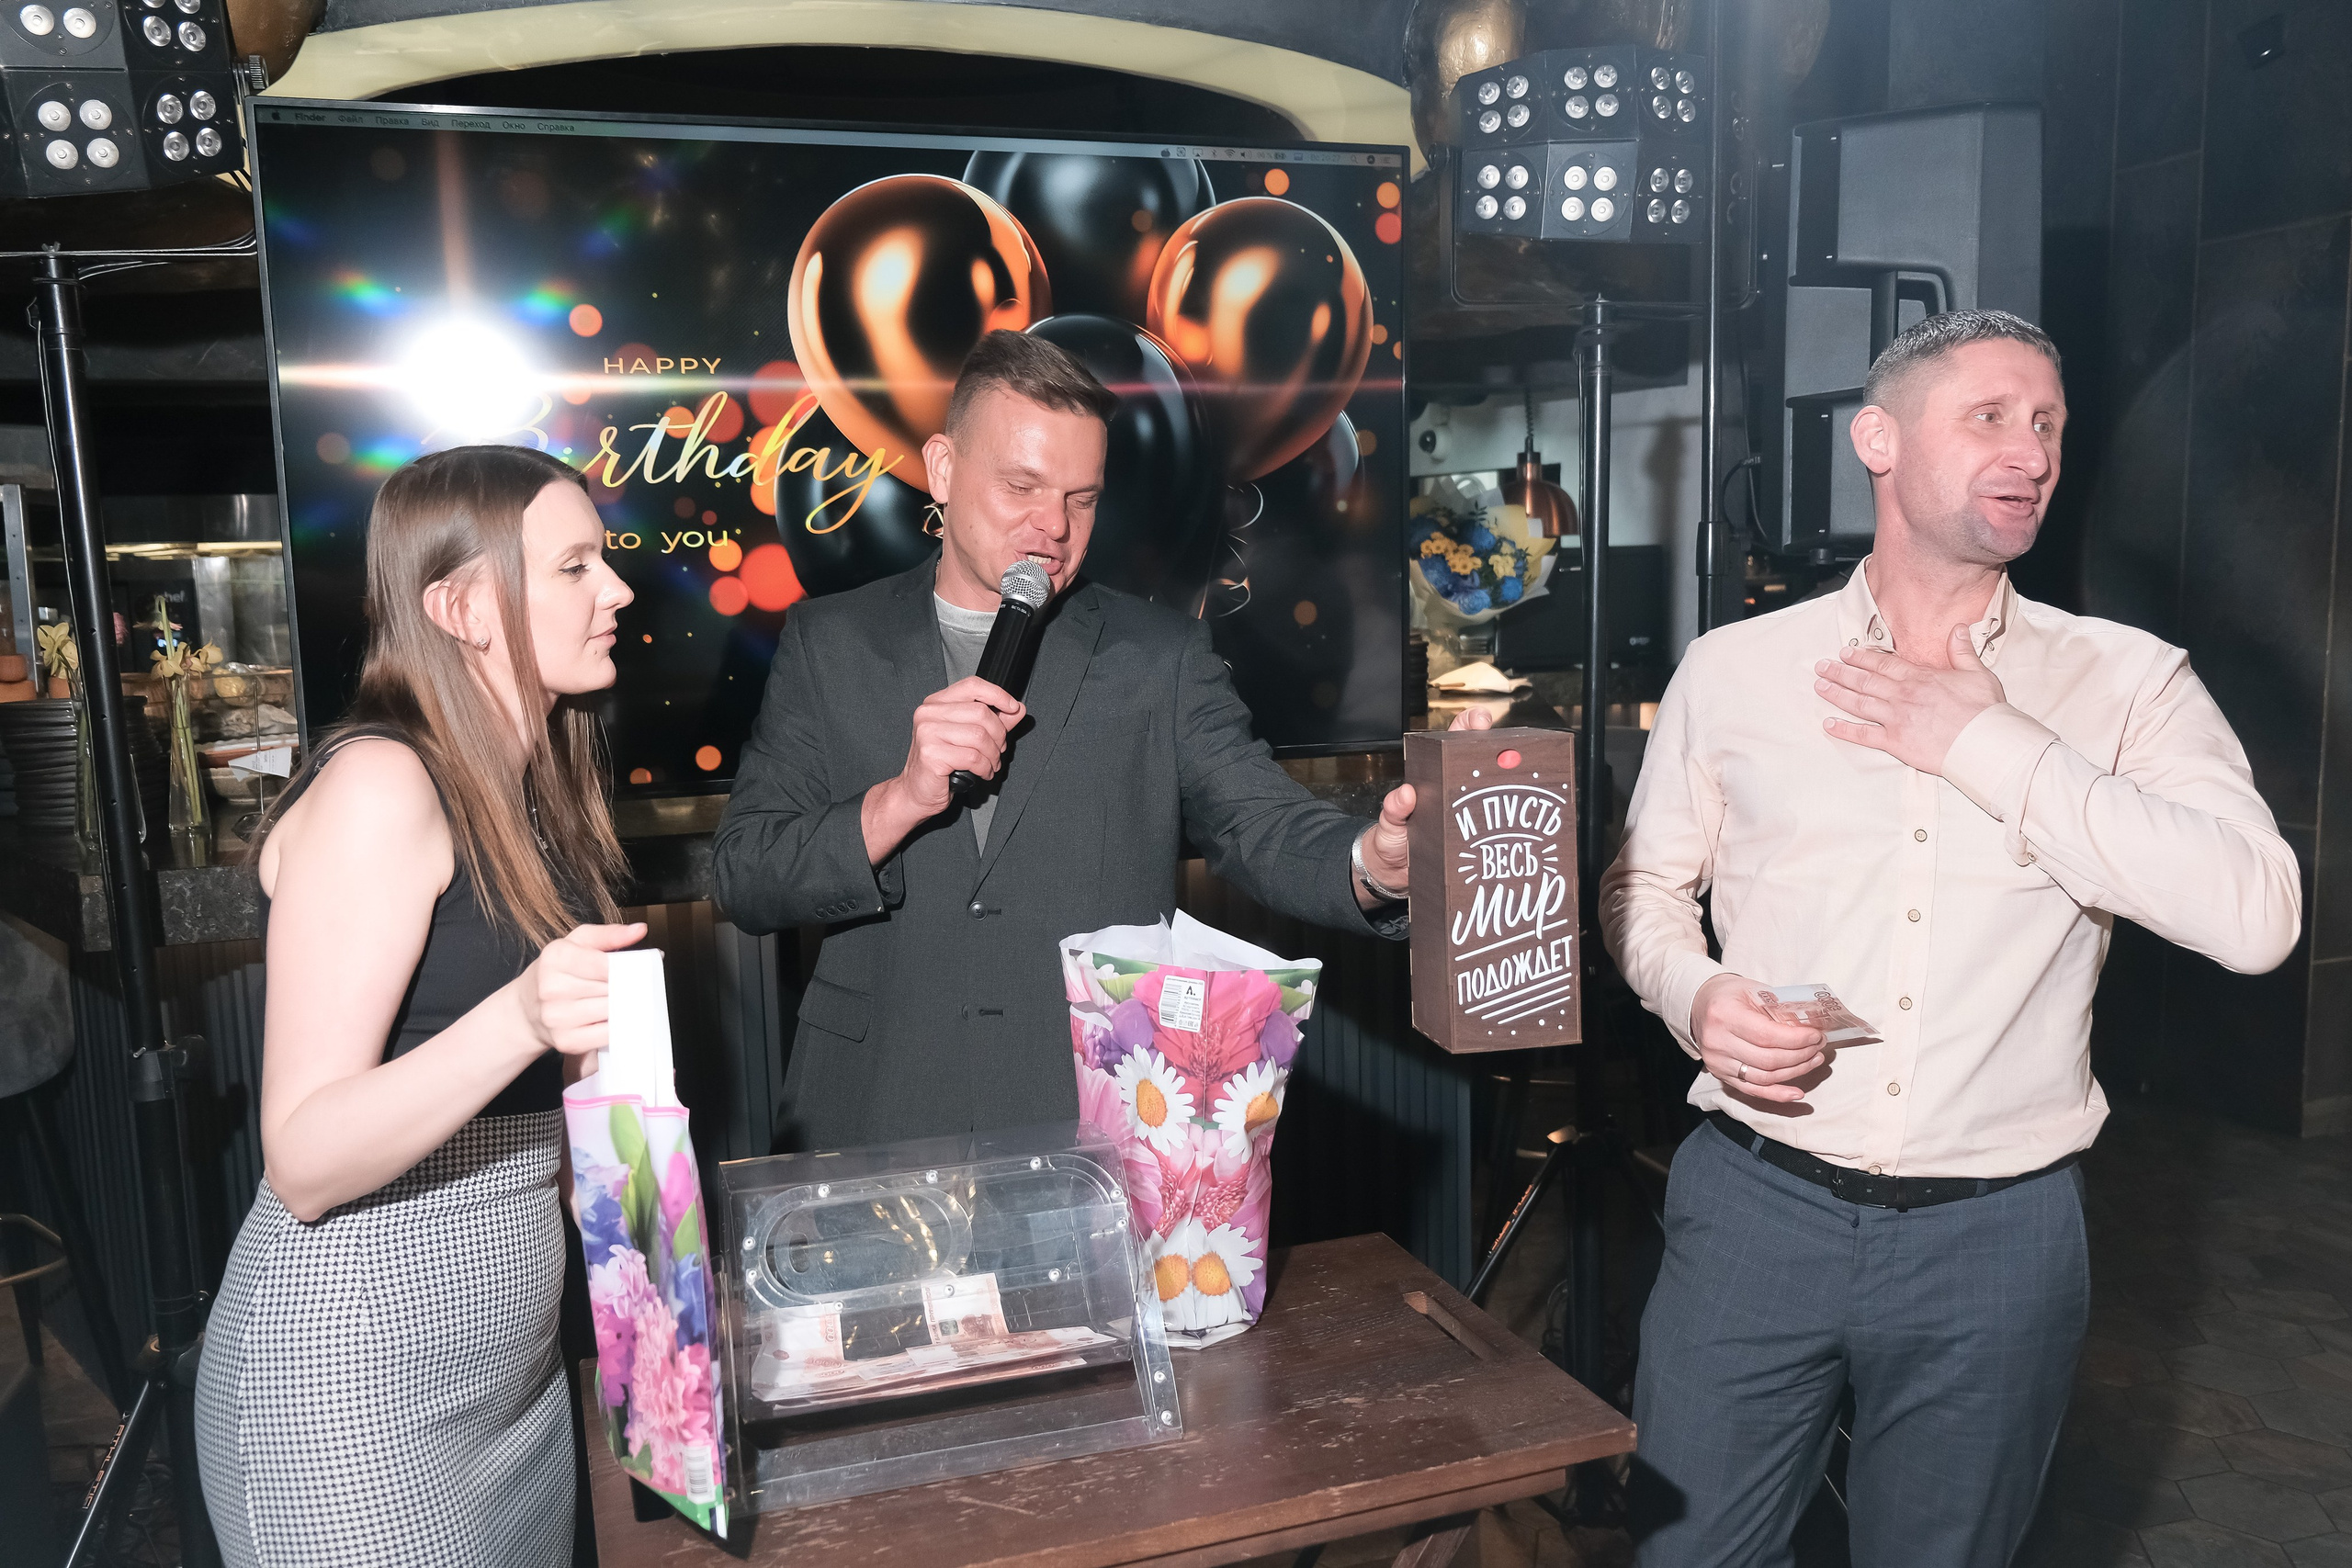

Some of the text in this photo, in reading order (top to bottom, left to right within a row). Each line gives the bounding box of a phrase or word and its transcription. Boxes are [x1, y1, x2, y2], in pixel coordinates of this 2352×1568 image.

[294, 112, 575, 133] Finder Файл Правка Вид Переход Окно Справка
[603, 357, 722, 375] HAPPY
[605, 529, 729, 554] to you
[1454, 794, 1562, 841] И ПУСТЬ
[1480, 841, 1539, 881] ВЕСЬ
[1457, 934, 1573, 1006] ПОДОЖДЕТ
